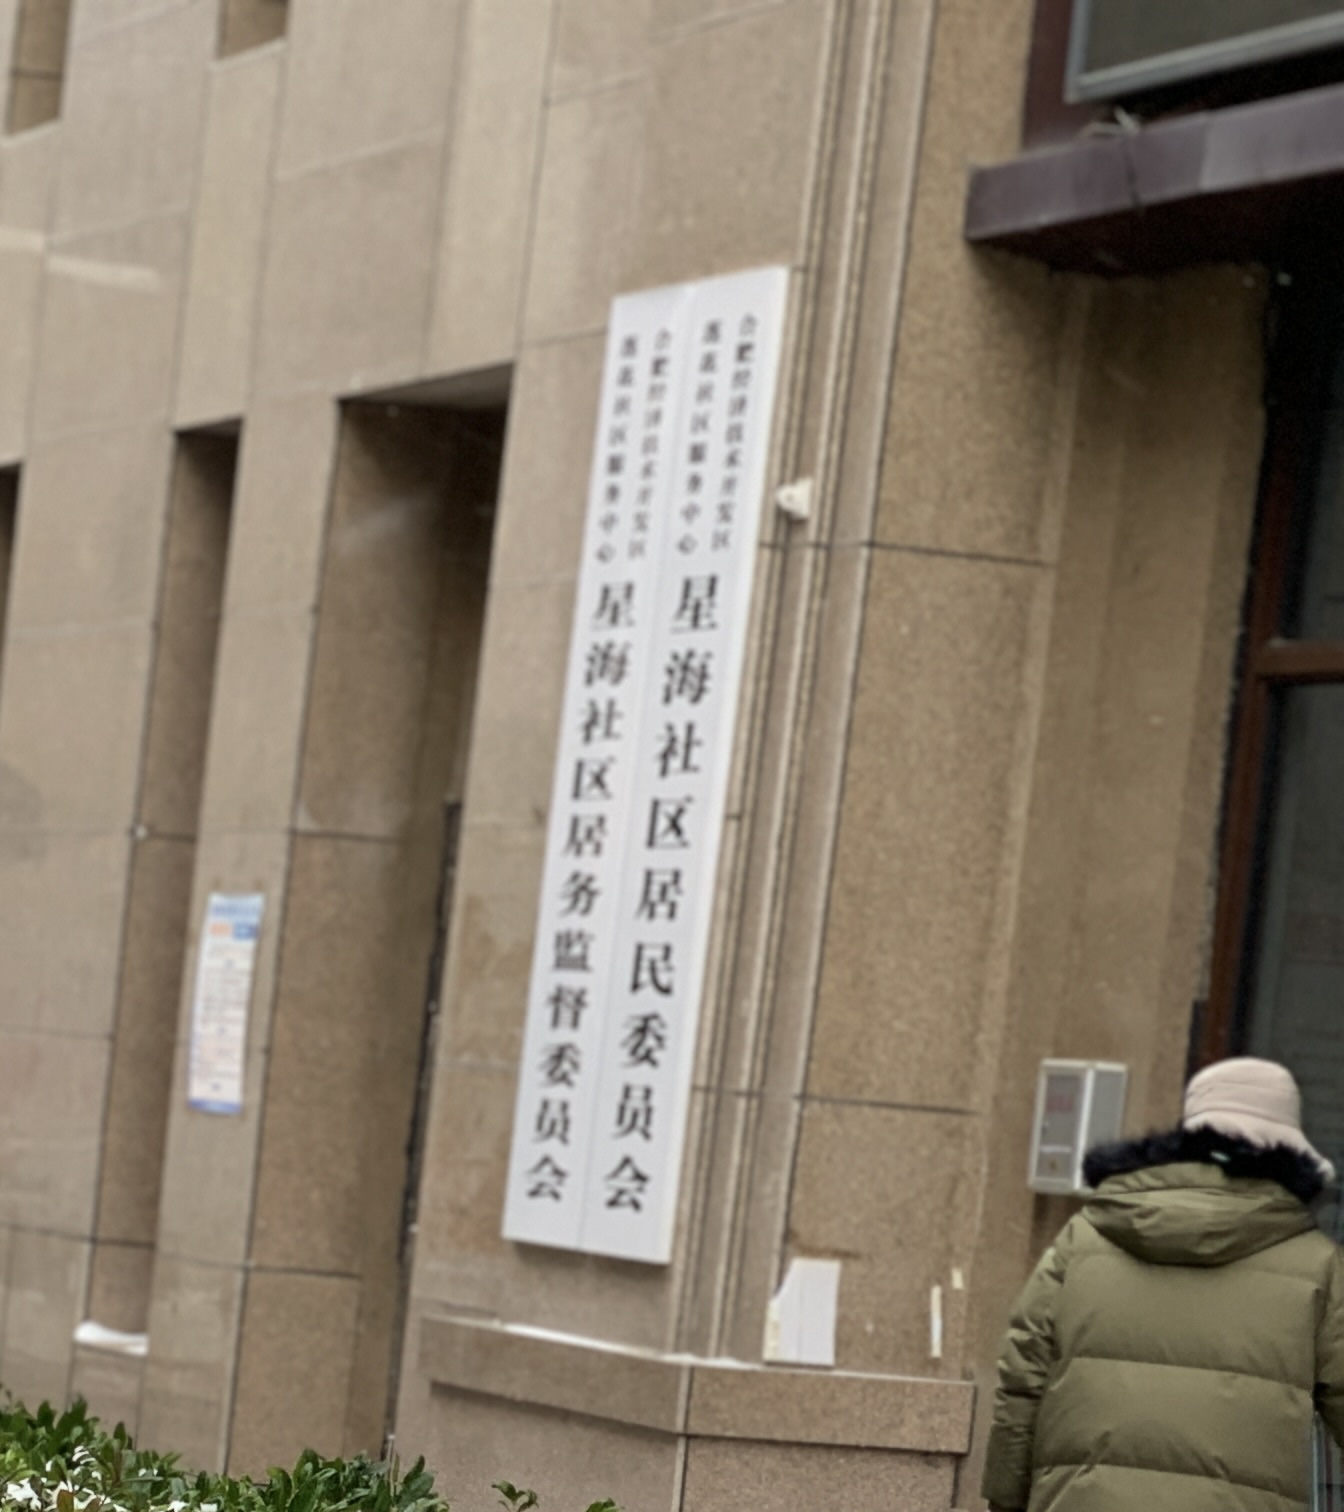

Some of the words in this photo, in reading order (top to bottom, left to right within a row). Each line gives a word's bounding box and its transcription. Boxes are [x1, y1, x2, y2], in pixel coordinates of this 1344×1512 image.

[525, 580, 637, 1202] 星海社区居务监督委员会
[603, 574, 720, 1214] 星海社区居民委员会
